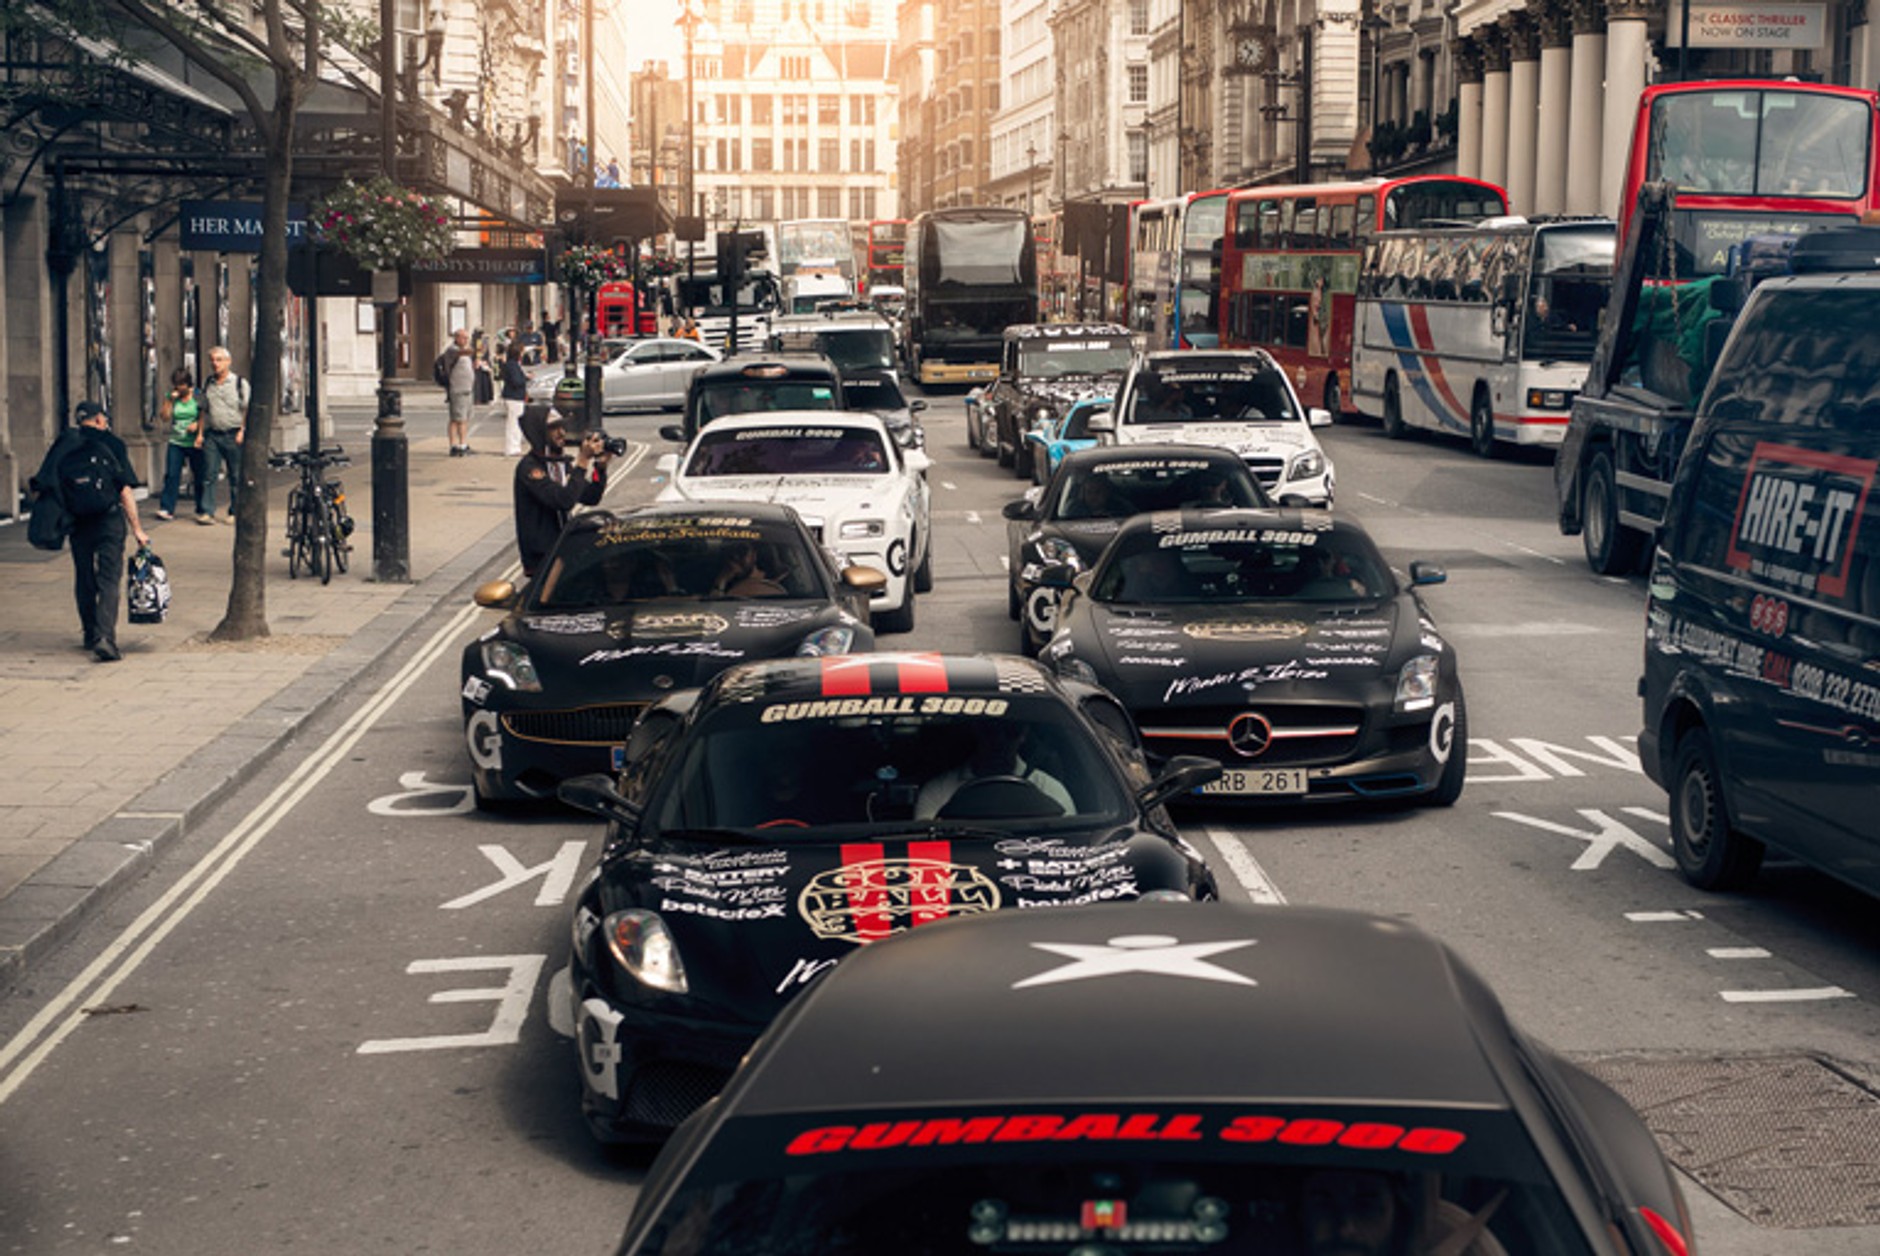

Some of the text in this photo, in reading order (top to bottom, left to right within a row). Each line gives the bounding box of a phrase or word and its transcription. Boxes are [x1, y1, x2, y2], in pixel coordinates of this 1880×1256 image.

[1708, 14, 1754, 25] CLASSIC
[1757, 15, 1806, 25] THRILLER
[1701, 27, 1791, 38] NOW ON STAGE
[191, 218, 229, 234] HER
[1740, 474, 1856, 563] HIRE-IT
[1159, 530, 1317, 548] GUMBALL 3000
[761, 697, 1009, 723] GUMBALL 3000
[1261, 772, 1301, 791] 261
[786, 1113, 1465, 1155] GUMBALL 3000
